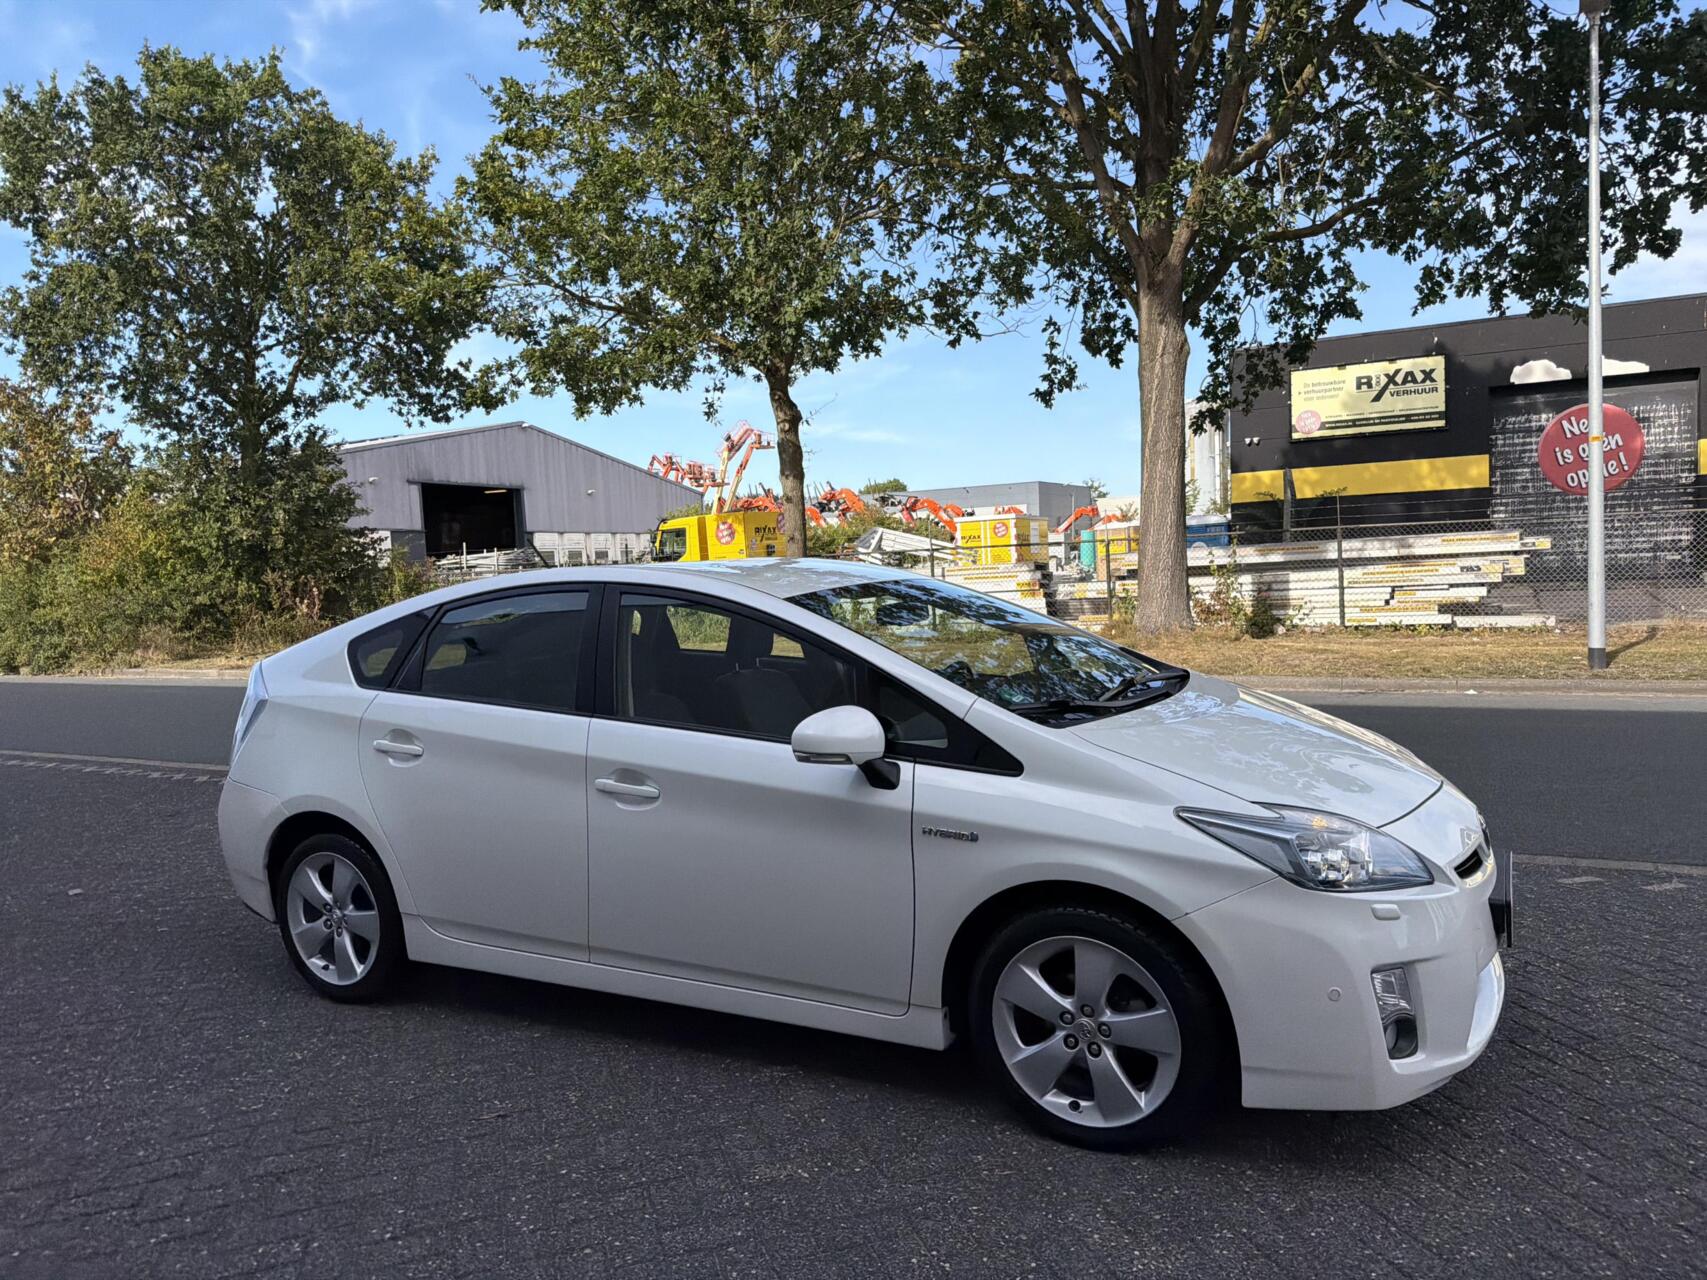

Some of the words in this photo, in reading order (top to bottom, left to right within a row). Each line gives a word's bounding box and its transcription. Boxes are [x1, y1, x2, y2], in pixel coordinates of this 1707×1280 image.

[1389, 387, 1439, 397] VERHUUR
[1561, 416, 1589, 438] Ne
[1555, 447, 1574, 466] is
[1579, 432, 1623, 461] gén
[1566, 452, 1629, 488] ope!
